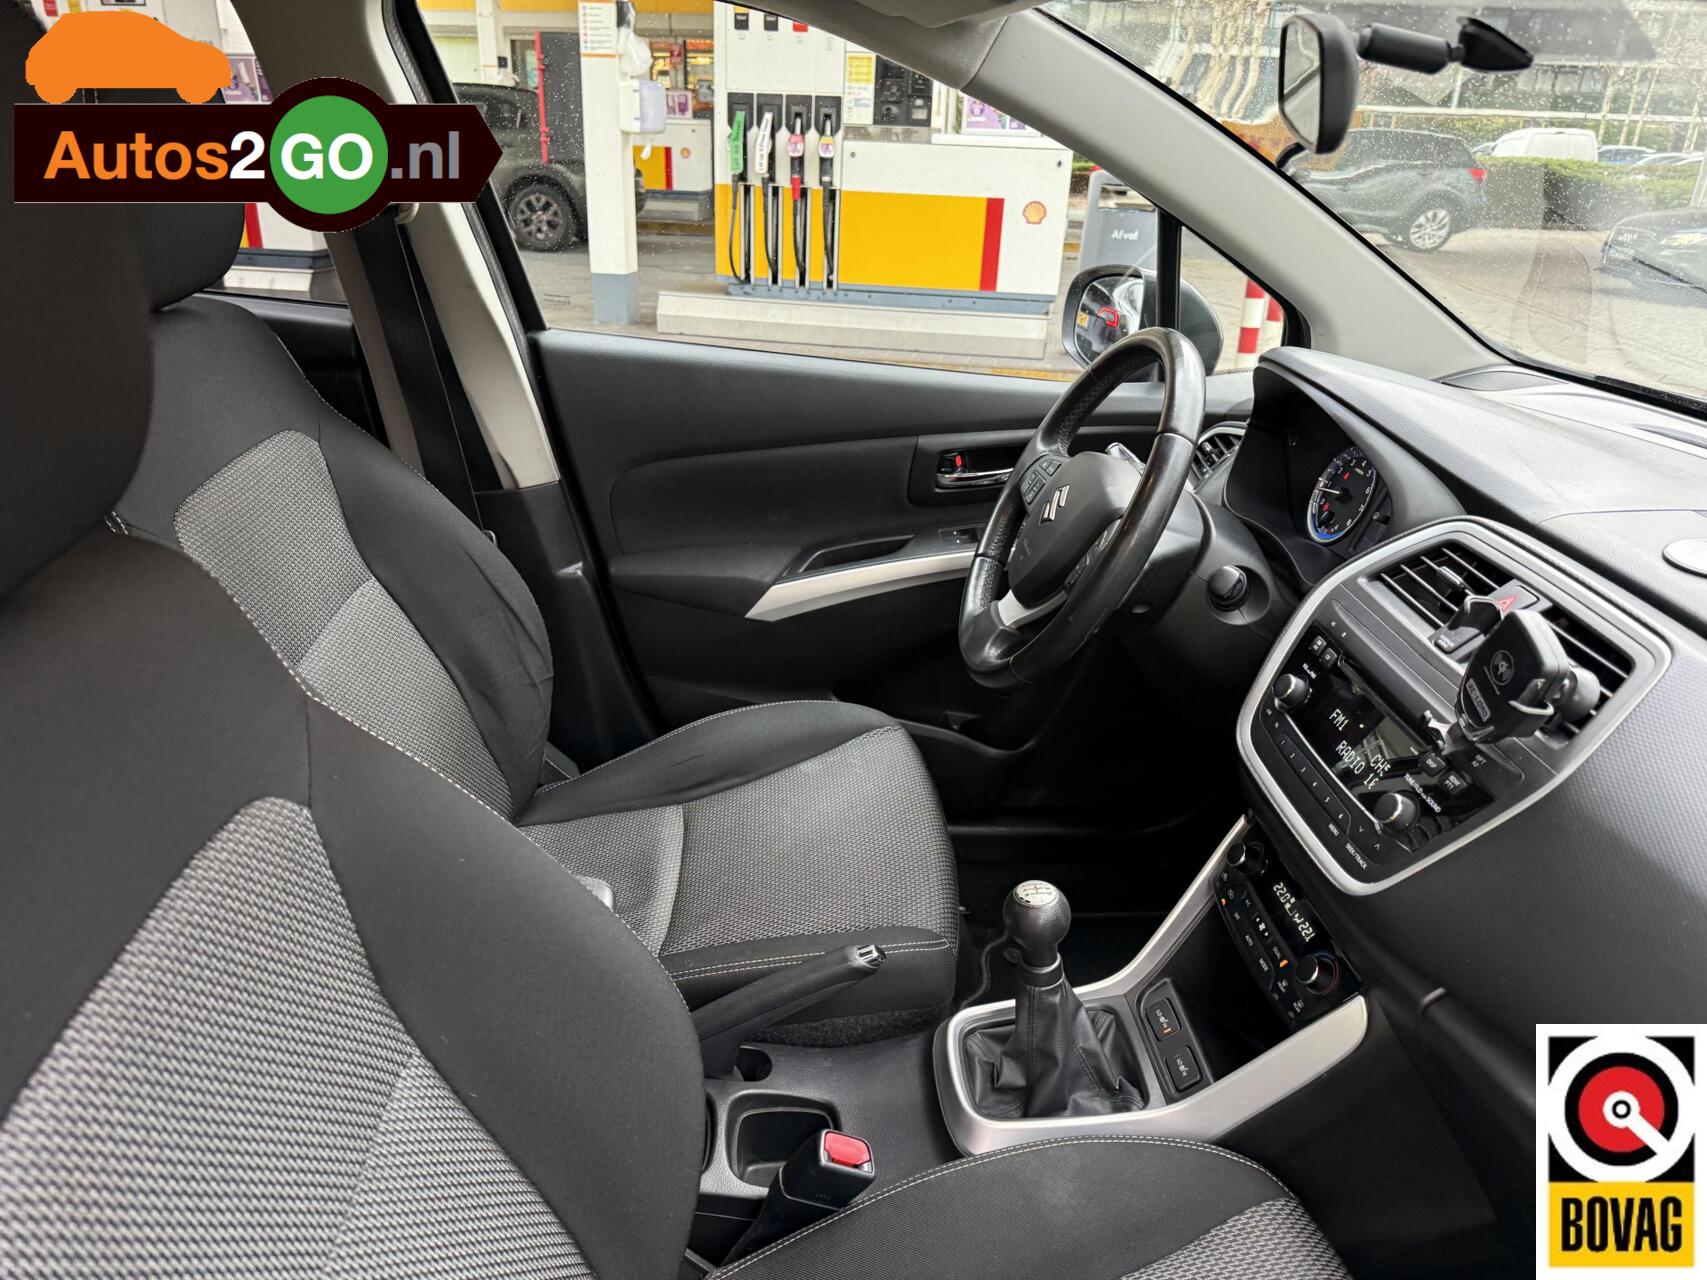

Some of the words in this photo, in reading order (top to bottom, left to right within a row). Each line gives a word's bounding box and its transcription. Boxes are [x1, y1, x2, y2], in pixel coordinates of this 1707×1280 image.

[1111, 229, 1139, 240] Afval
[1328, 708, 1350, 732] FM1
[1335, 739, 1367, 776] RADIO
[1427, 796, 1442, 813] SOUND
[1327, 822, 1340, 837] MENU
